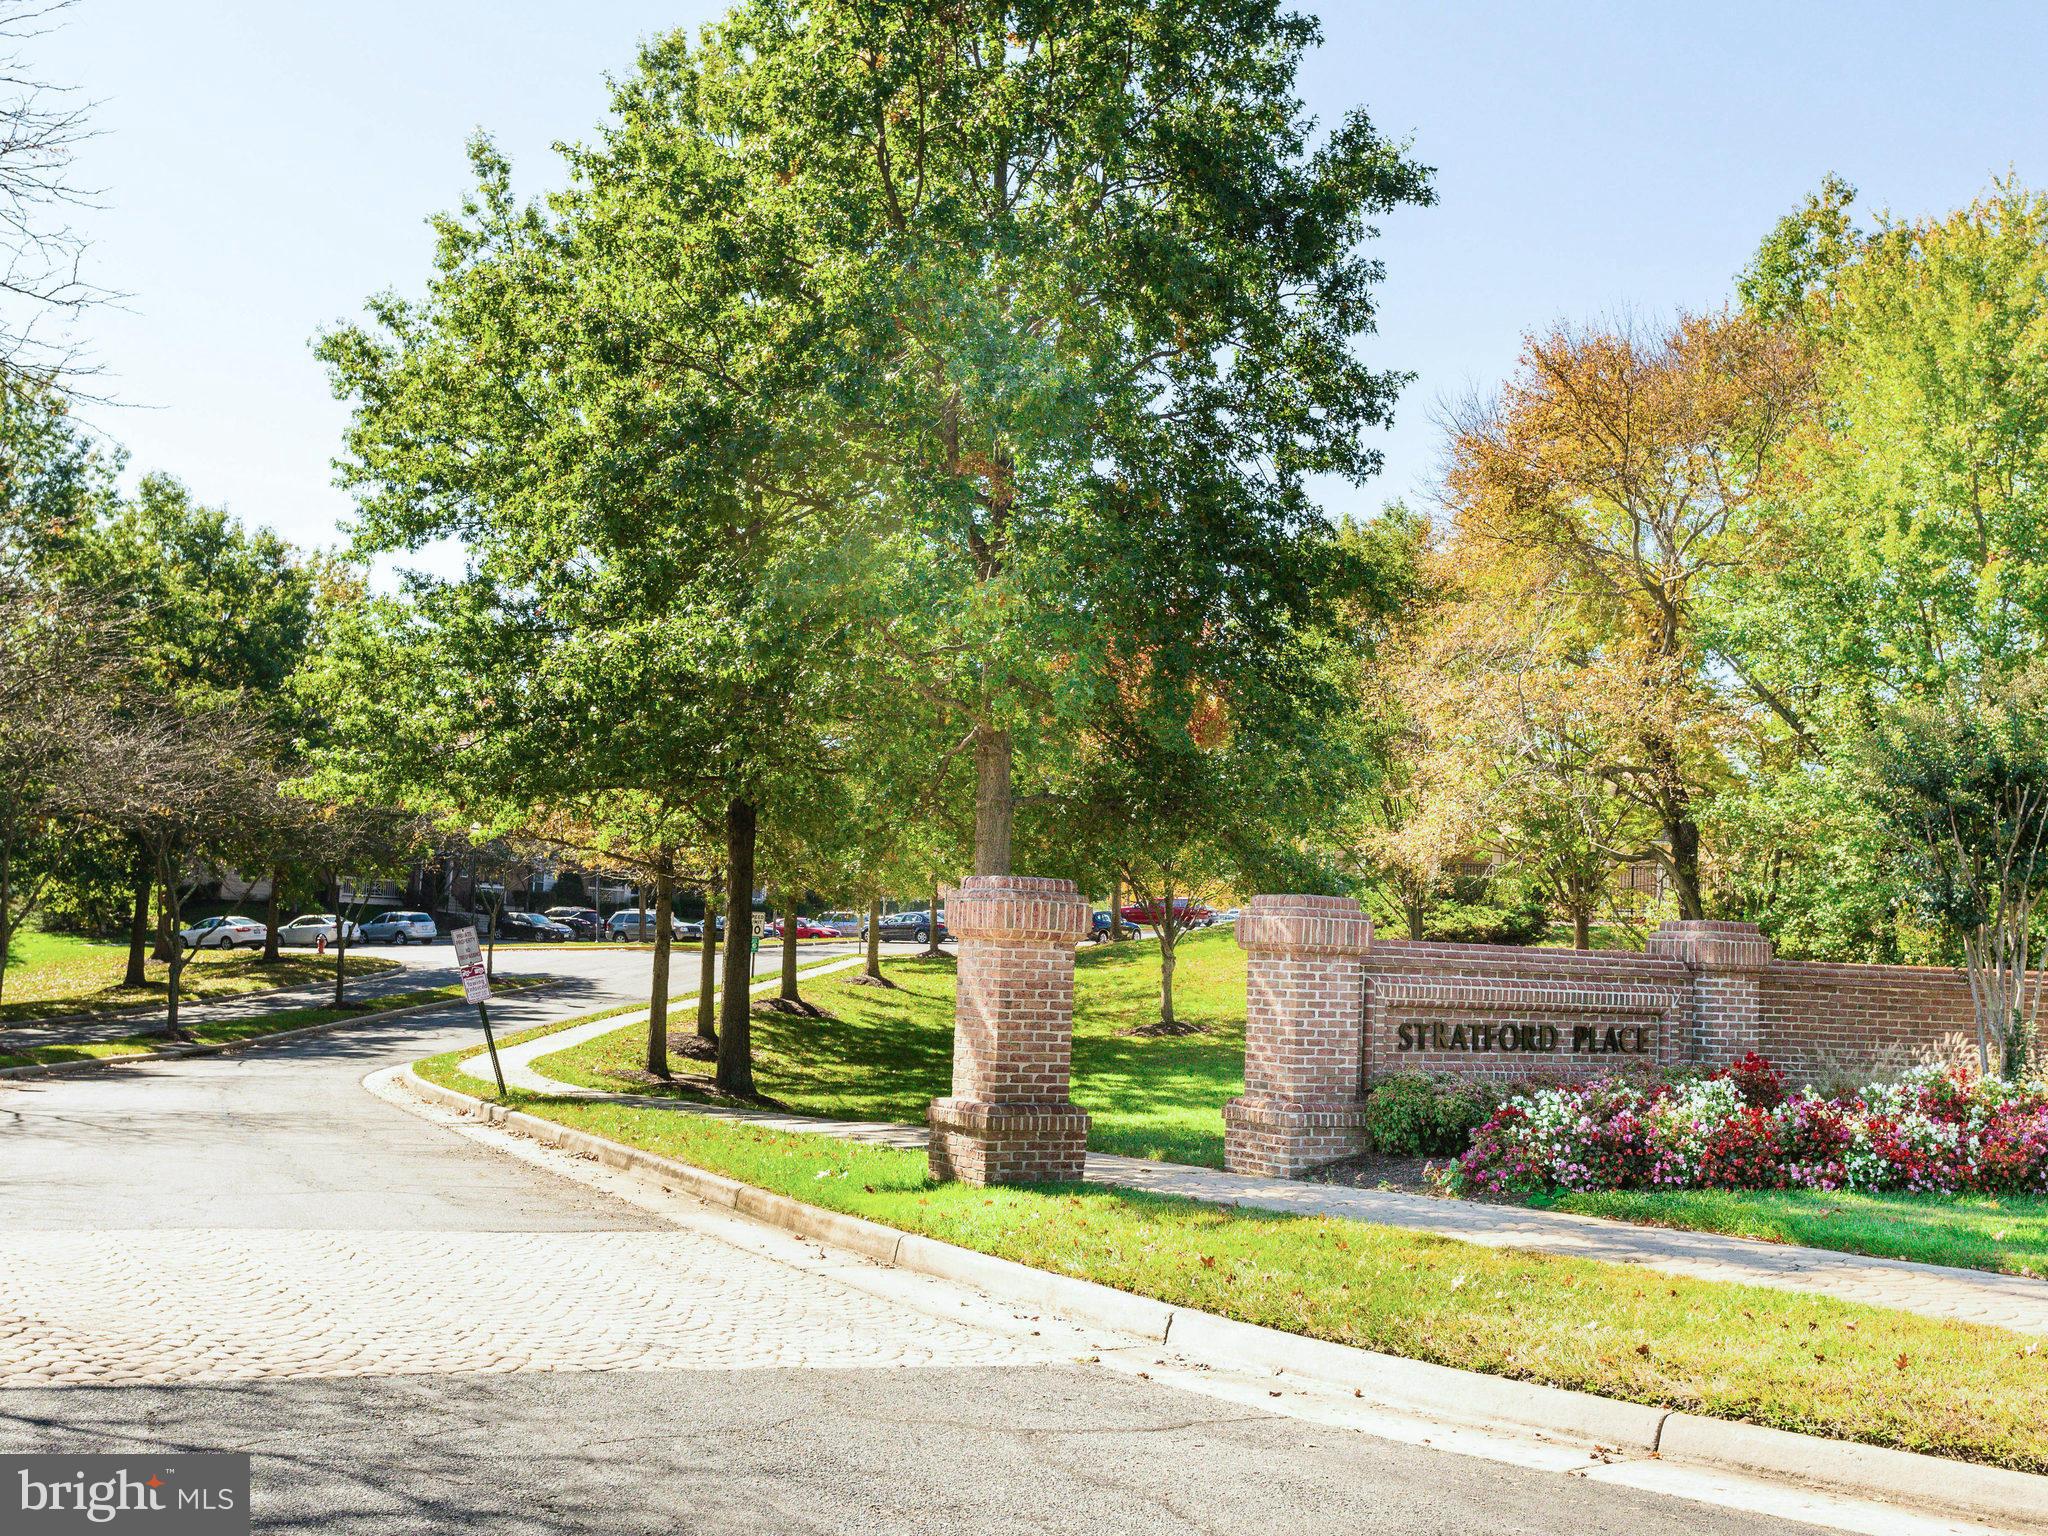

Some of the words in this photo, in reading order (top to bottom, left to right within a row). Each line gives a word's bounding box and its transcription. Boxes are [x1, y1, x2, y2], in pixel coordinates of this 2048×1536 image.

[456, 937, 475, 945] PROPERTY
[1398, 1021, 1559, 1052] STRATFORD
[1573, 1025, 1653, 1054] PLACE
